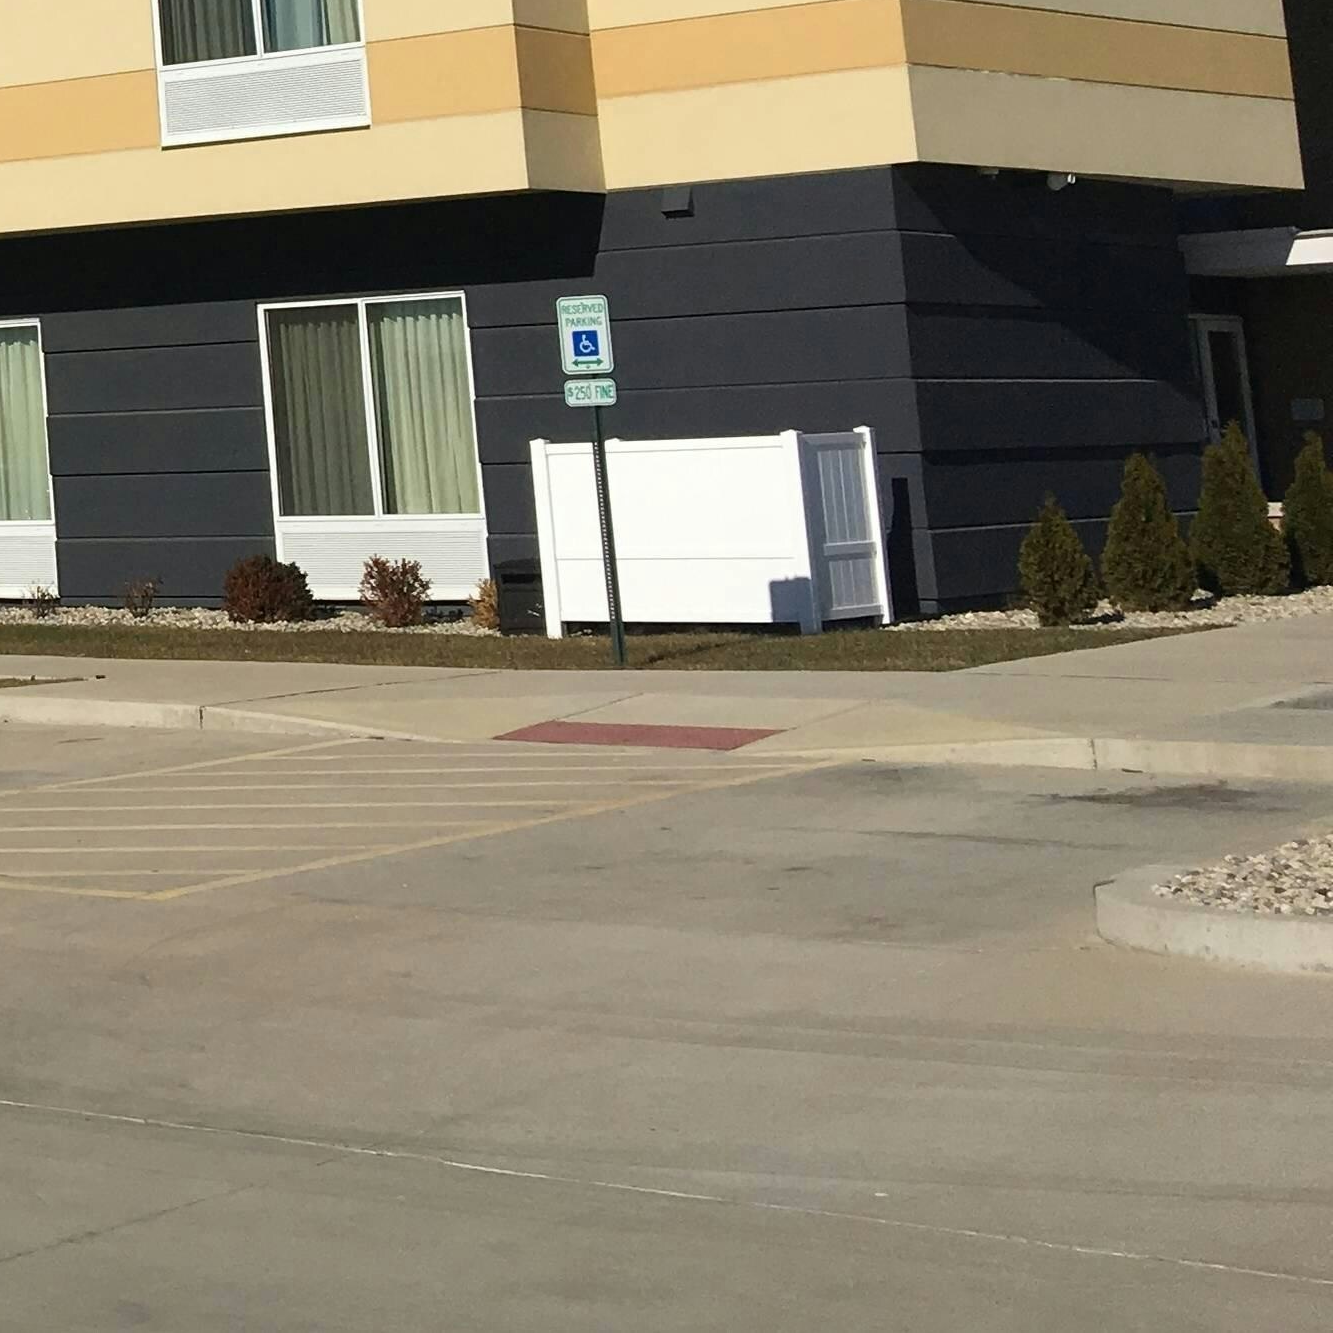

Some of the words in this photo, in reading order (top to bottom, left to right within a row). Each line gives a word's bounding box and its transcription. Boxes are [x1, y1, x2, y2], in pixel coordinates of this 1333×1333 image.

[561, 303, 604, 315] RESERVED
[564, 316, 603, 327] PARKING
[594, 384, 615, 400] FINE
